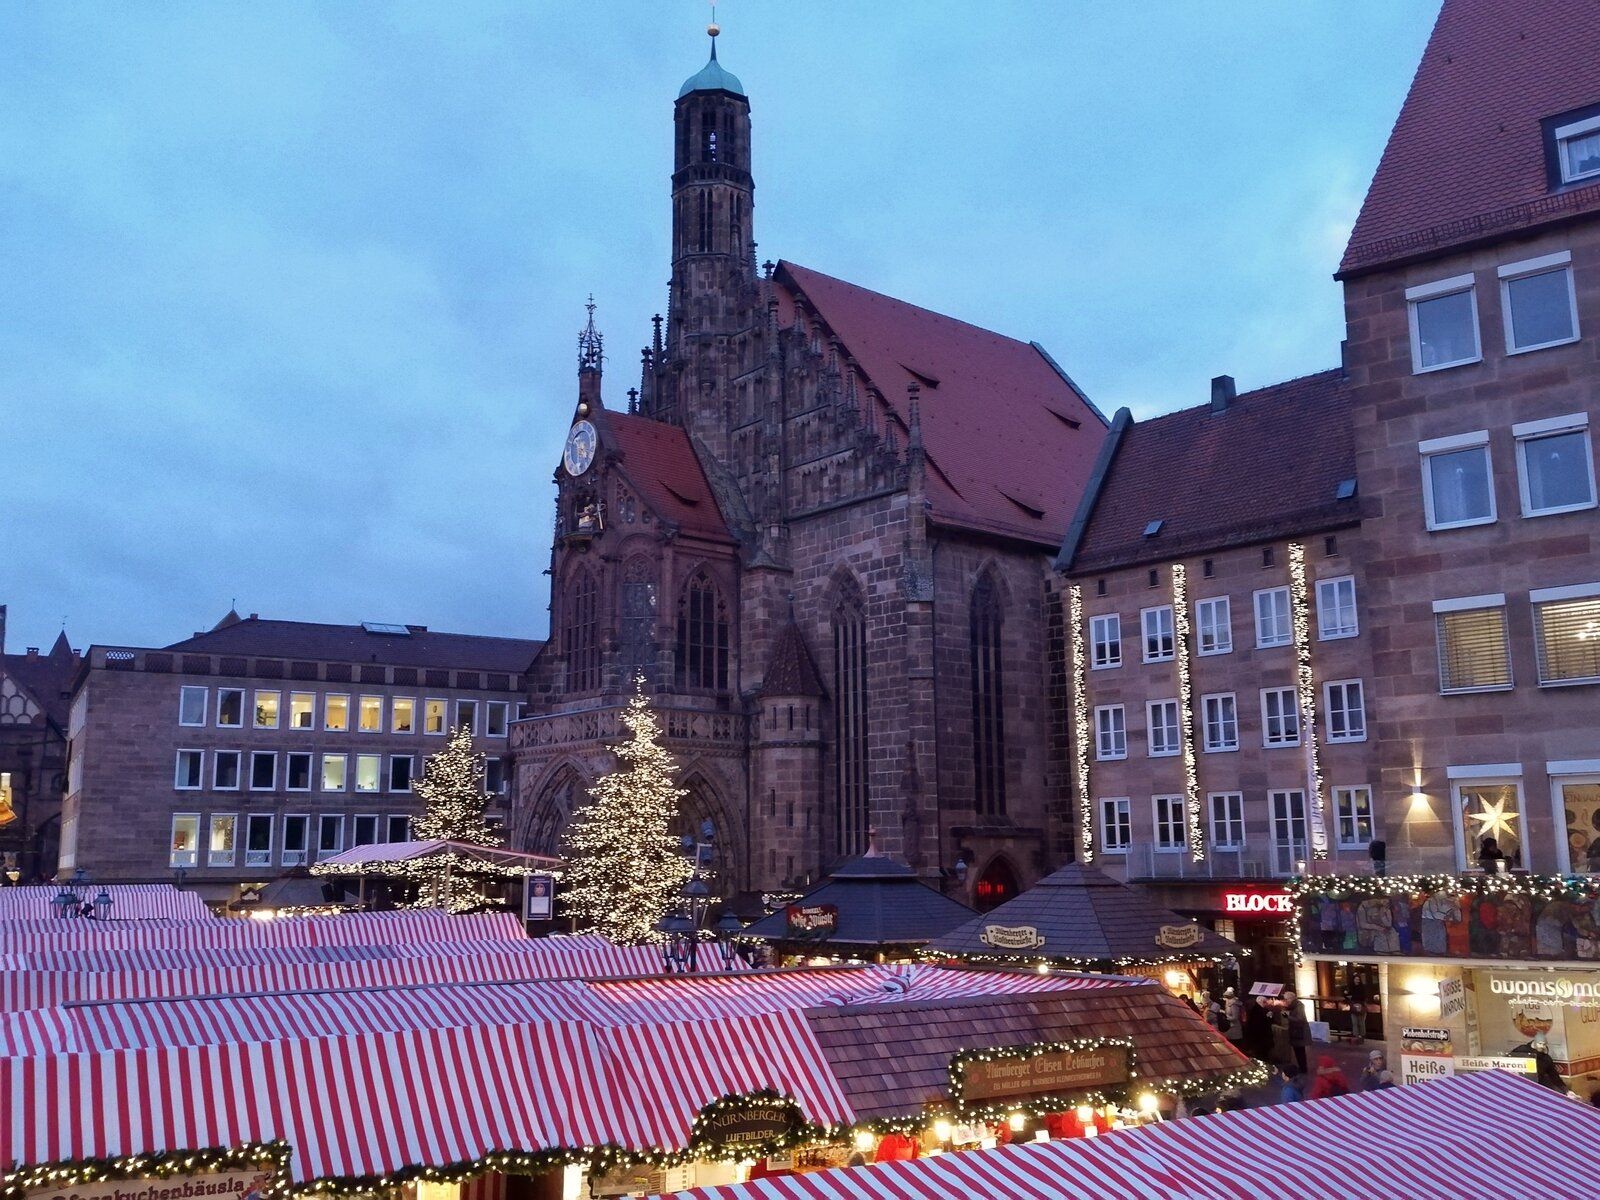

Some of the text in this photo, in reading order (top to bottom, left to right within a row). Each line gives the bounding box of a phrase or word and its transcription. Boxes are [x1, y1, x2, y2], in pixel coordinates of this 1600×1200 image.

[1225, 894, 1293, 911] BLOCK
[985, 1062, 1031, 1078] Nürnberger
[1410, 1061, 1446, 1075] Heiße
[1462, 1059, 1489, 1067] Heiße
[713, 1110, 787, 1129] NÜRNBERGER
[725, 1129, 775, 1142] LUFTBILDER
[52, 1176, 244, 1200] nkuchenhäusla
